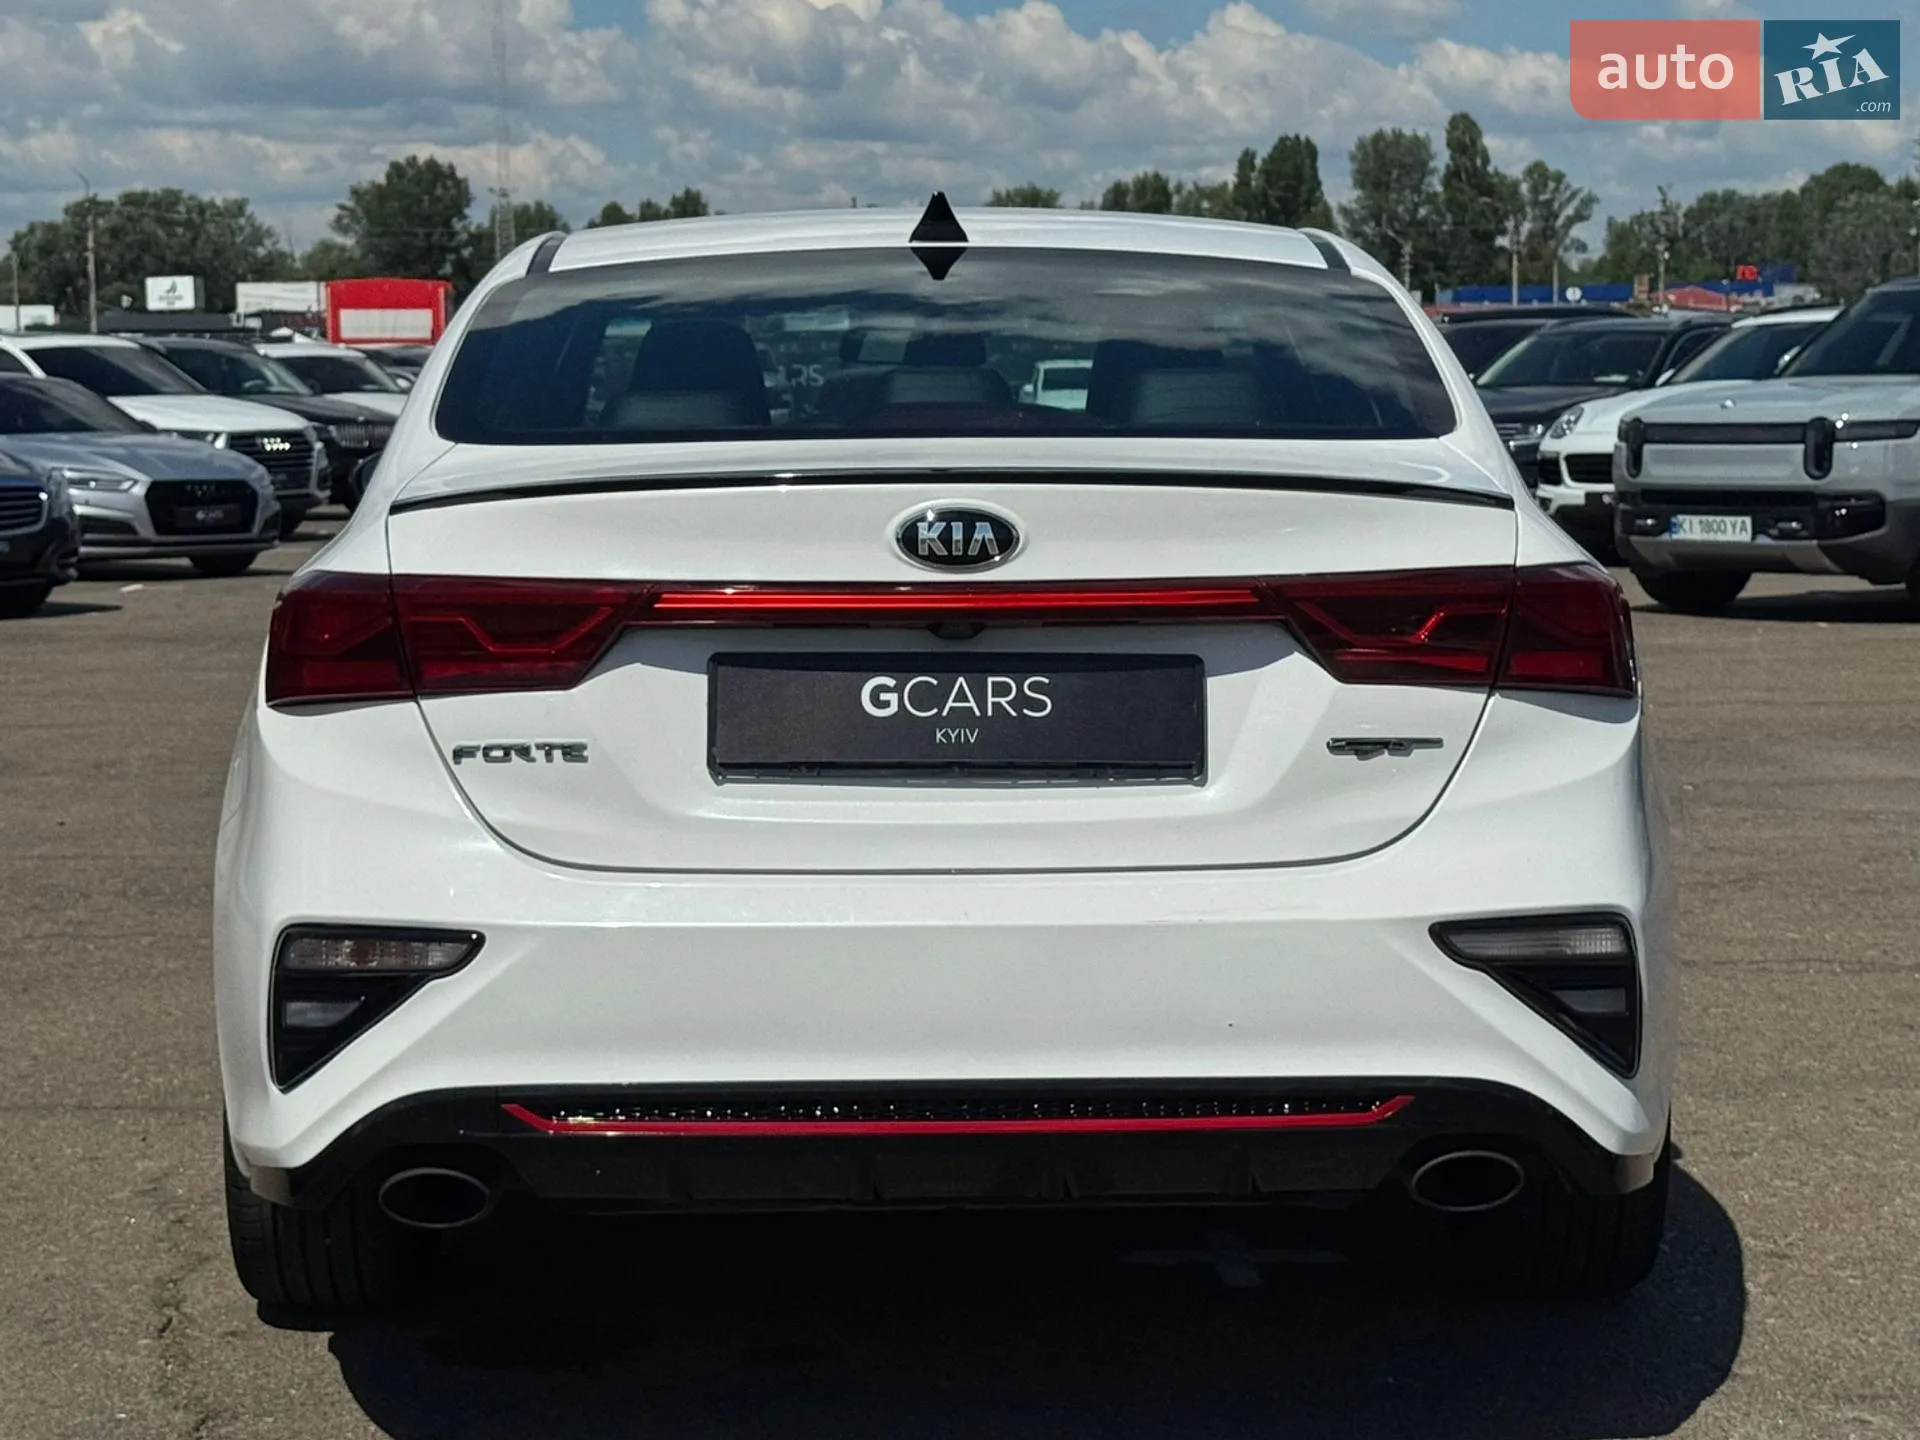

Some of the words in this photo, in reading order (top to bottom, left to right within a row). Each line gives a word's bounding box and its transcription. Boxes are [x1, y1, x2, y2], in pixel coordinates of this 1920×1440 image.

[916, 521, 999, 556] KIA
[1728, 519, 1748, 534] YA
[860, 675, 1052, 718] GCARS
[935, 728, 979, 744] KYIV
[452, 741, 589, 765] FORTE
